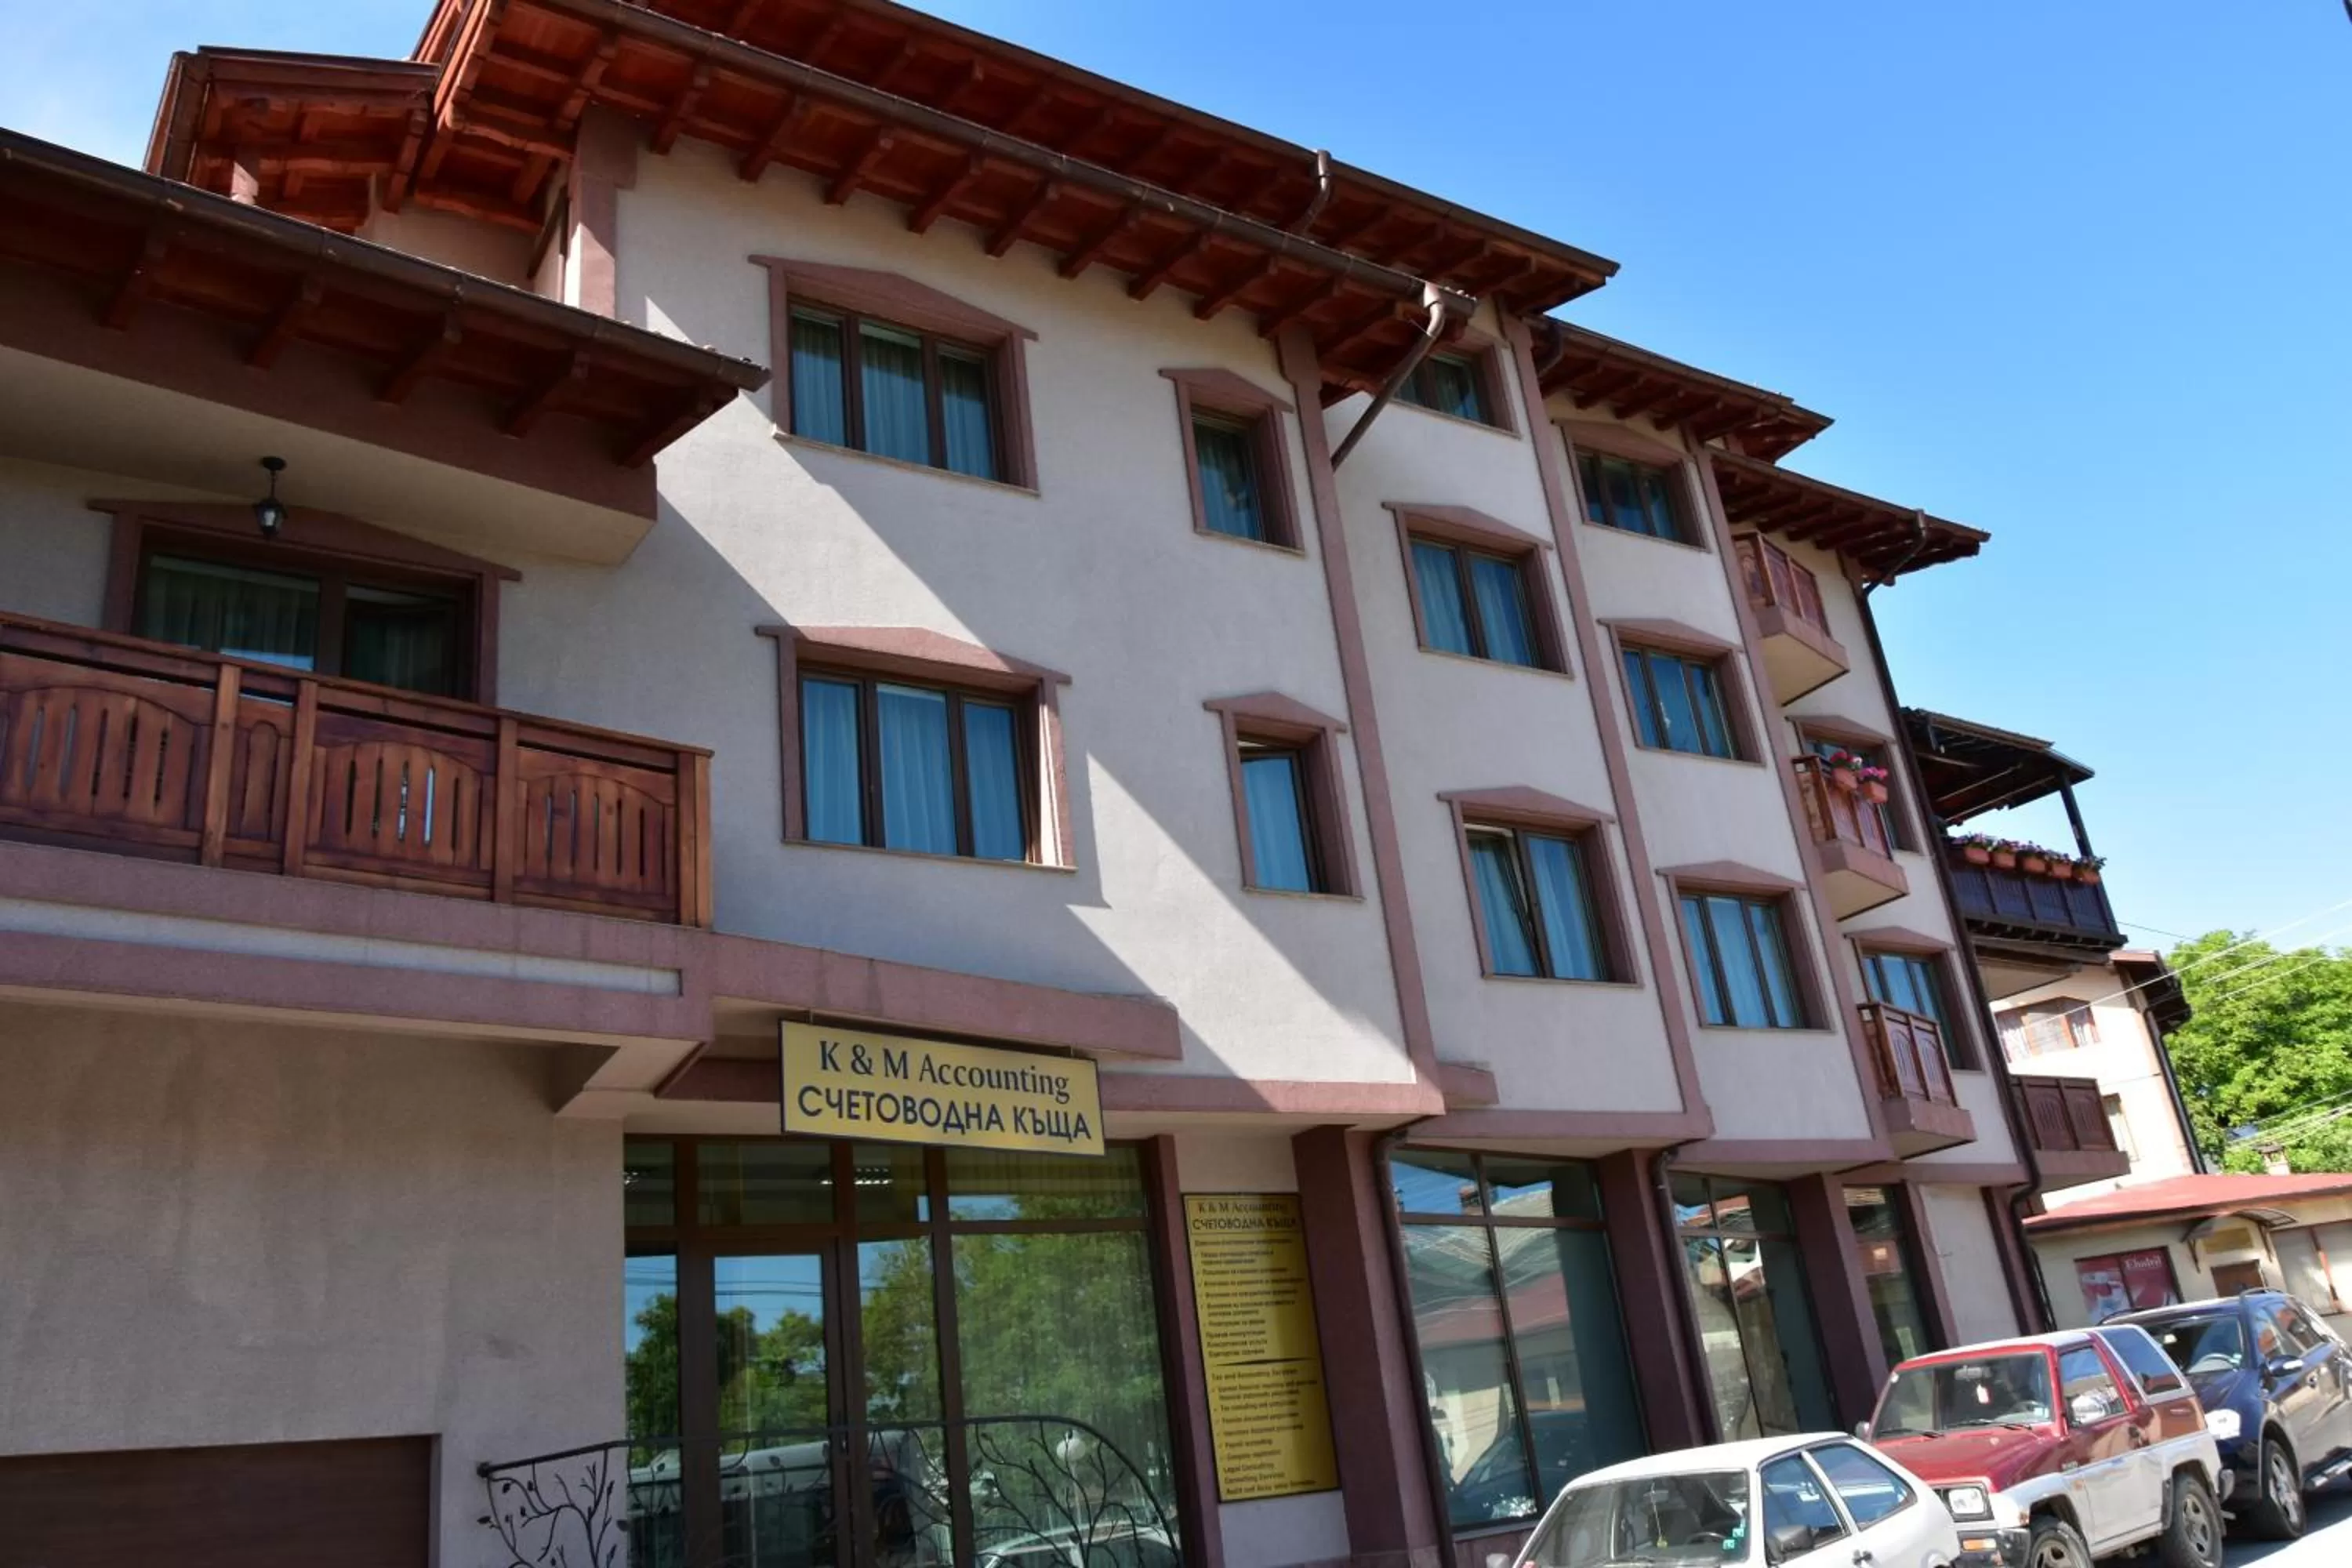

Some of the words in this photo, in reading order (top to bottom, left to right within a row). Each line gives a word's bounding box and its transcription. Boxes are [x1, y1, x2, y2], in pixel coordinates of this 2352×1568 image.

[819, 1040, 841, 1073] K
[851, 1044, 874, 1076] &
[883, 1047, 909, 1080] M
[919, 1053, 1070, 1105] Accounting
[797, 1084, 1006, 1135] СЧЕТОВОДНА
[1013, 1105, 1092, 1143] КЪЩА
